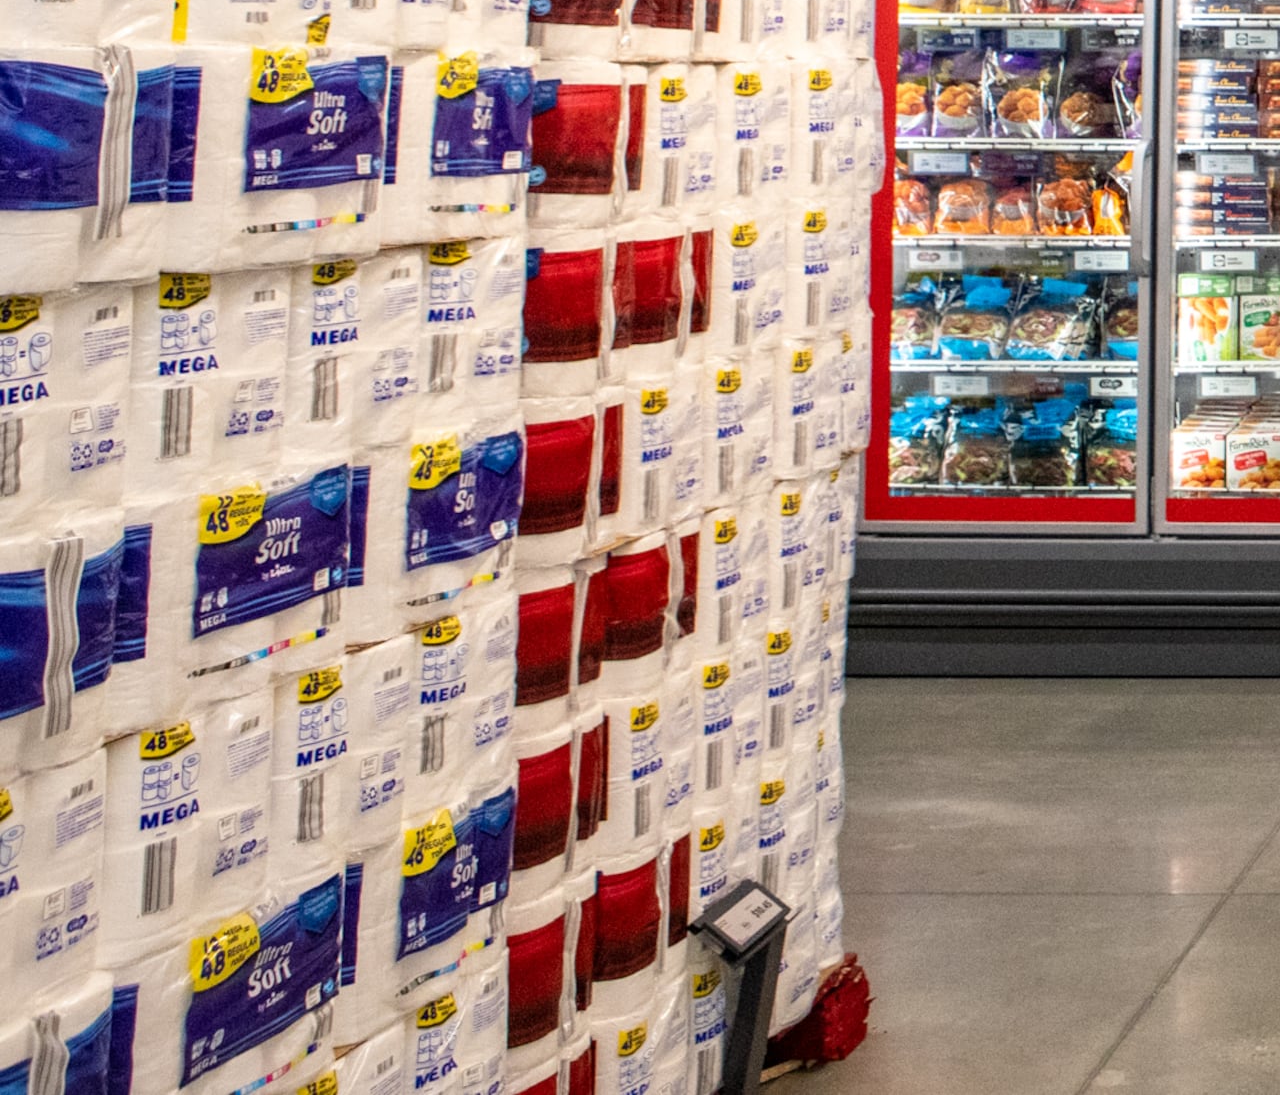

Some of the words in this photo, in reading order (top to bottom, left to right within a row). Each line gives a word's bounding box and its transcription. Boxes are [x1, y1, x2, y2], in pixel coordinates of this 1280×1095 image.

[313, 91, 346, 108] Ultra
[306, 110, 348, 135] Soft
[316, 265, 335, 278] 48
[162, 287, 186, 302] 48
[427, 307, 476, 323] MEGA
[311, 327, 358, 346] MEGA
[159, 354, 219, 376] MEGA
[431, 457, 460, 469] REGULAR
[229, 504, 260, 520] REGULAR
[265, 516, 301, 538] Ultra
[255, 537, 301, 565] Soft
[200, 613, 227, 632] MEGA
[420, 682, 466, 705] MEGA
[145, 736, 167, 751] 48
[297, 740, 348, 767] MEGA
[632, 759, 663, 781] MEGA
[140, 799, 200, 831] MEGA
[425, 834, 454, 851] REGULAR
[201, 953, 226, 980] 48
[227, 936, 258, 958] REGULAR
[255, 942, 293, 969] Ultra
[248, 962, 292, 998] Soft
[190, 1057, 217, 1078] MEGA
